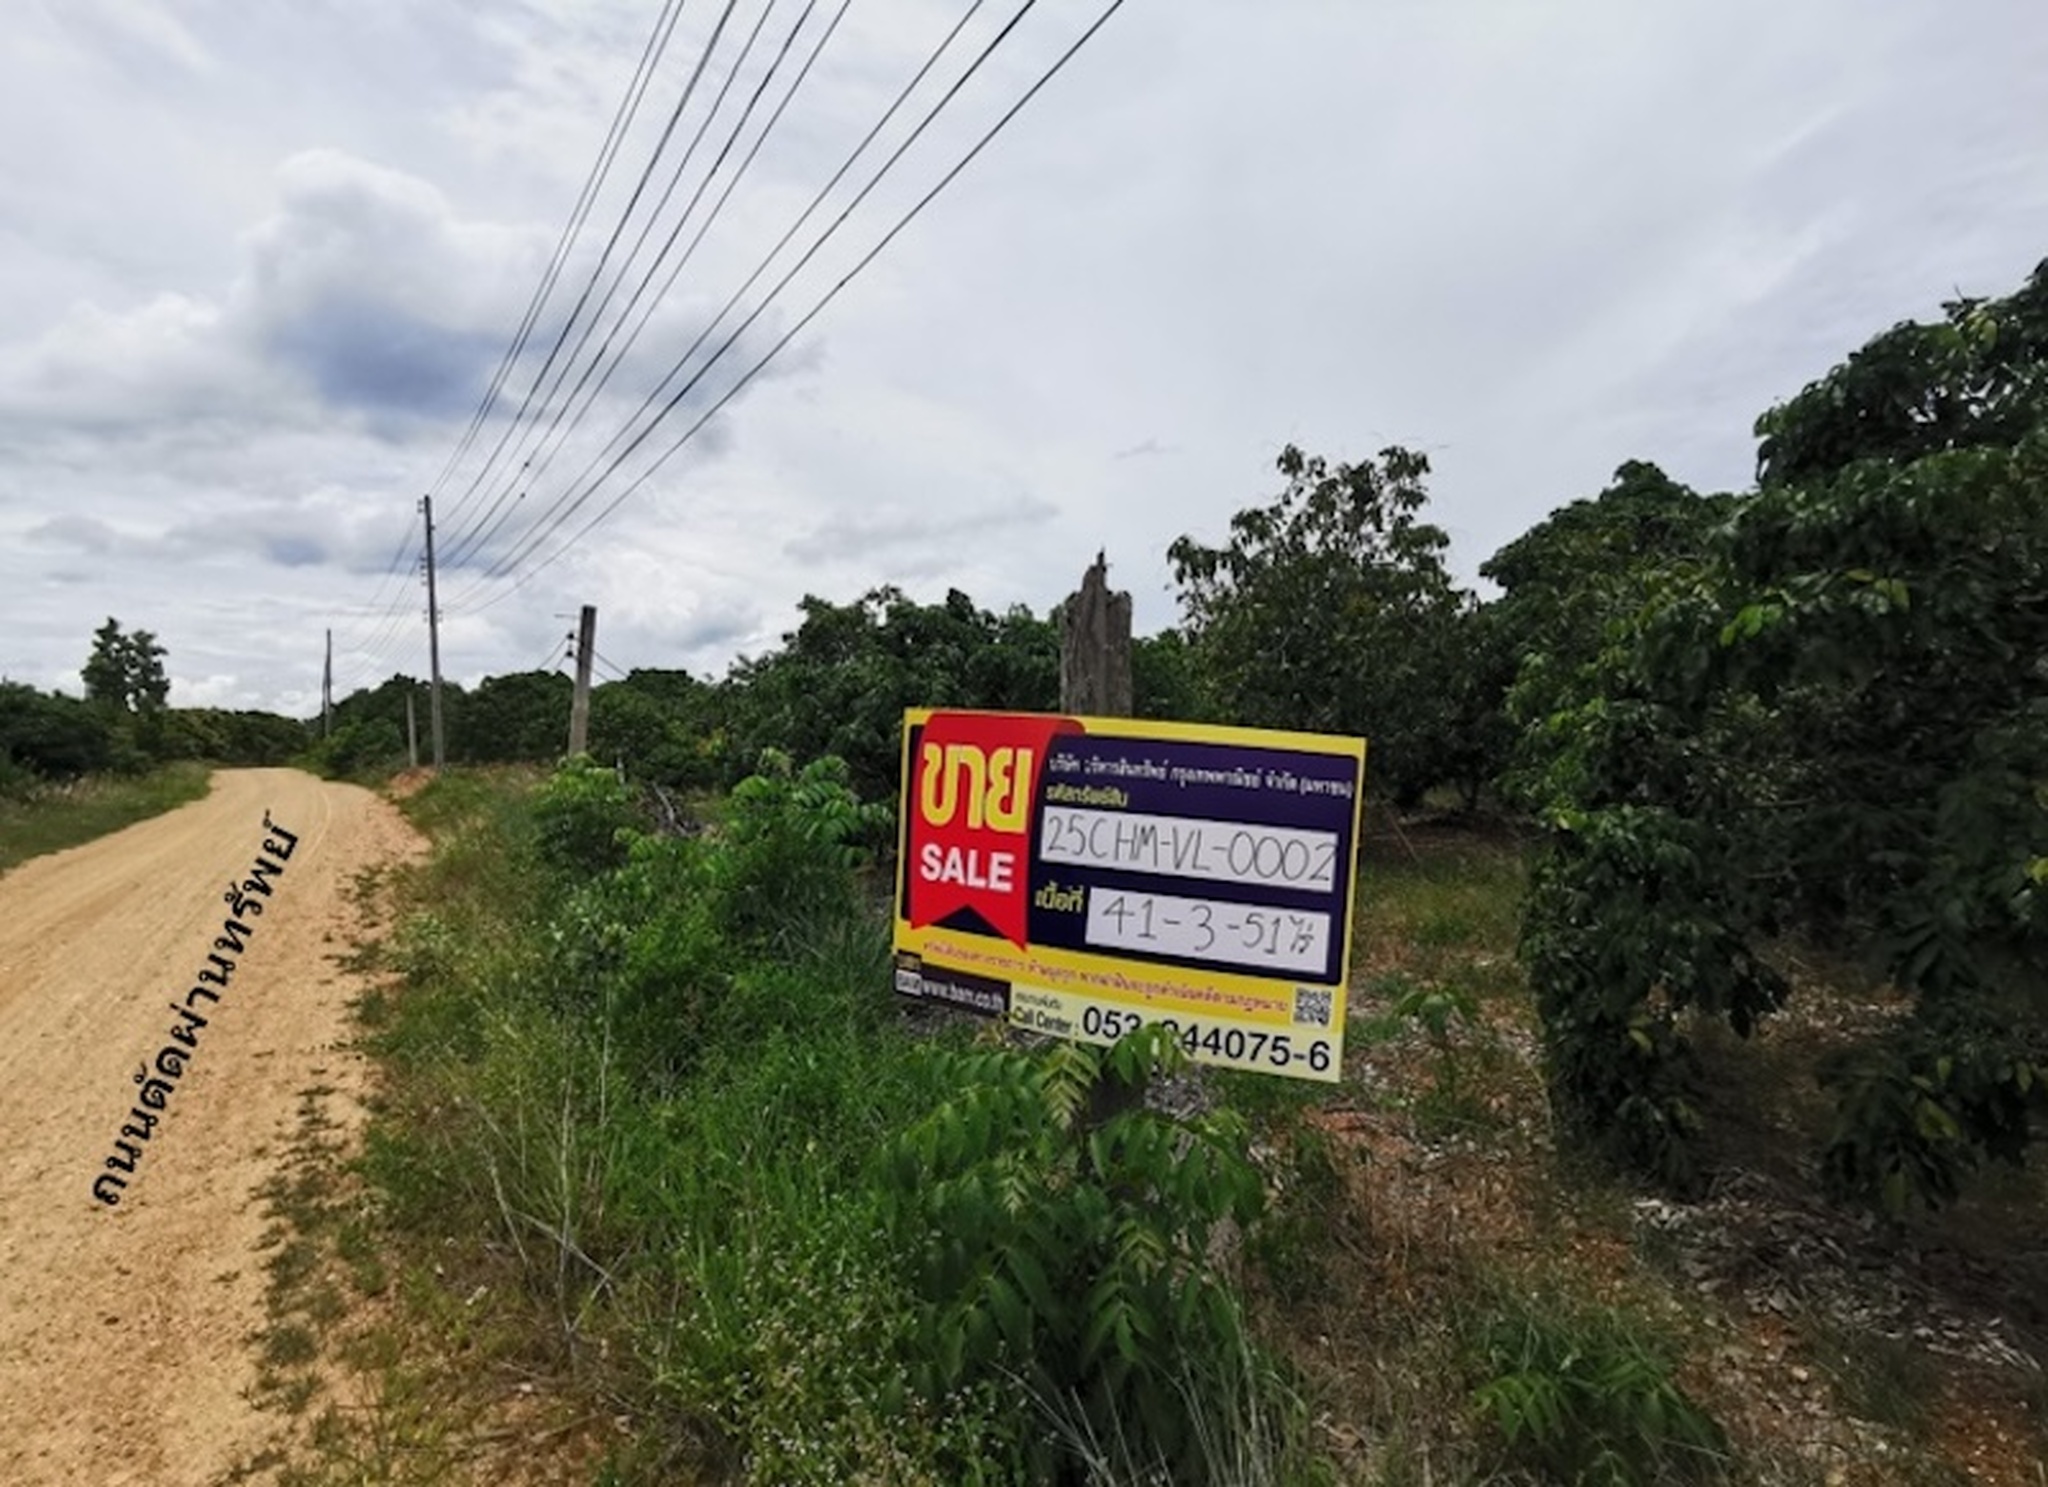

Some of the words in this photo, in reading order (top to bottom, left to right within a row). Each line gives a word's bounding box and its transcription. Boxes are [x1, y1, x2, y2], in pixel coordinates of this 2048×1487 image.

[921, 742, 1033, 834] ขาย
[920, 843, 1015, 892] SALE
[1048, 814, 1337, 882] 25CHM-VL-0002
[1034, 880, 1084, 912] เนื้อที่
